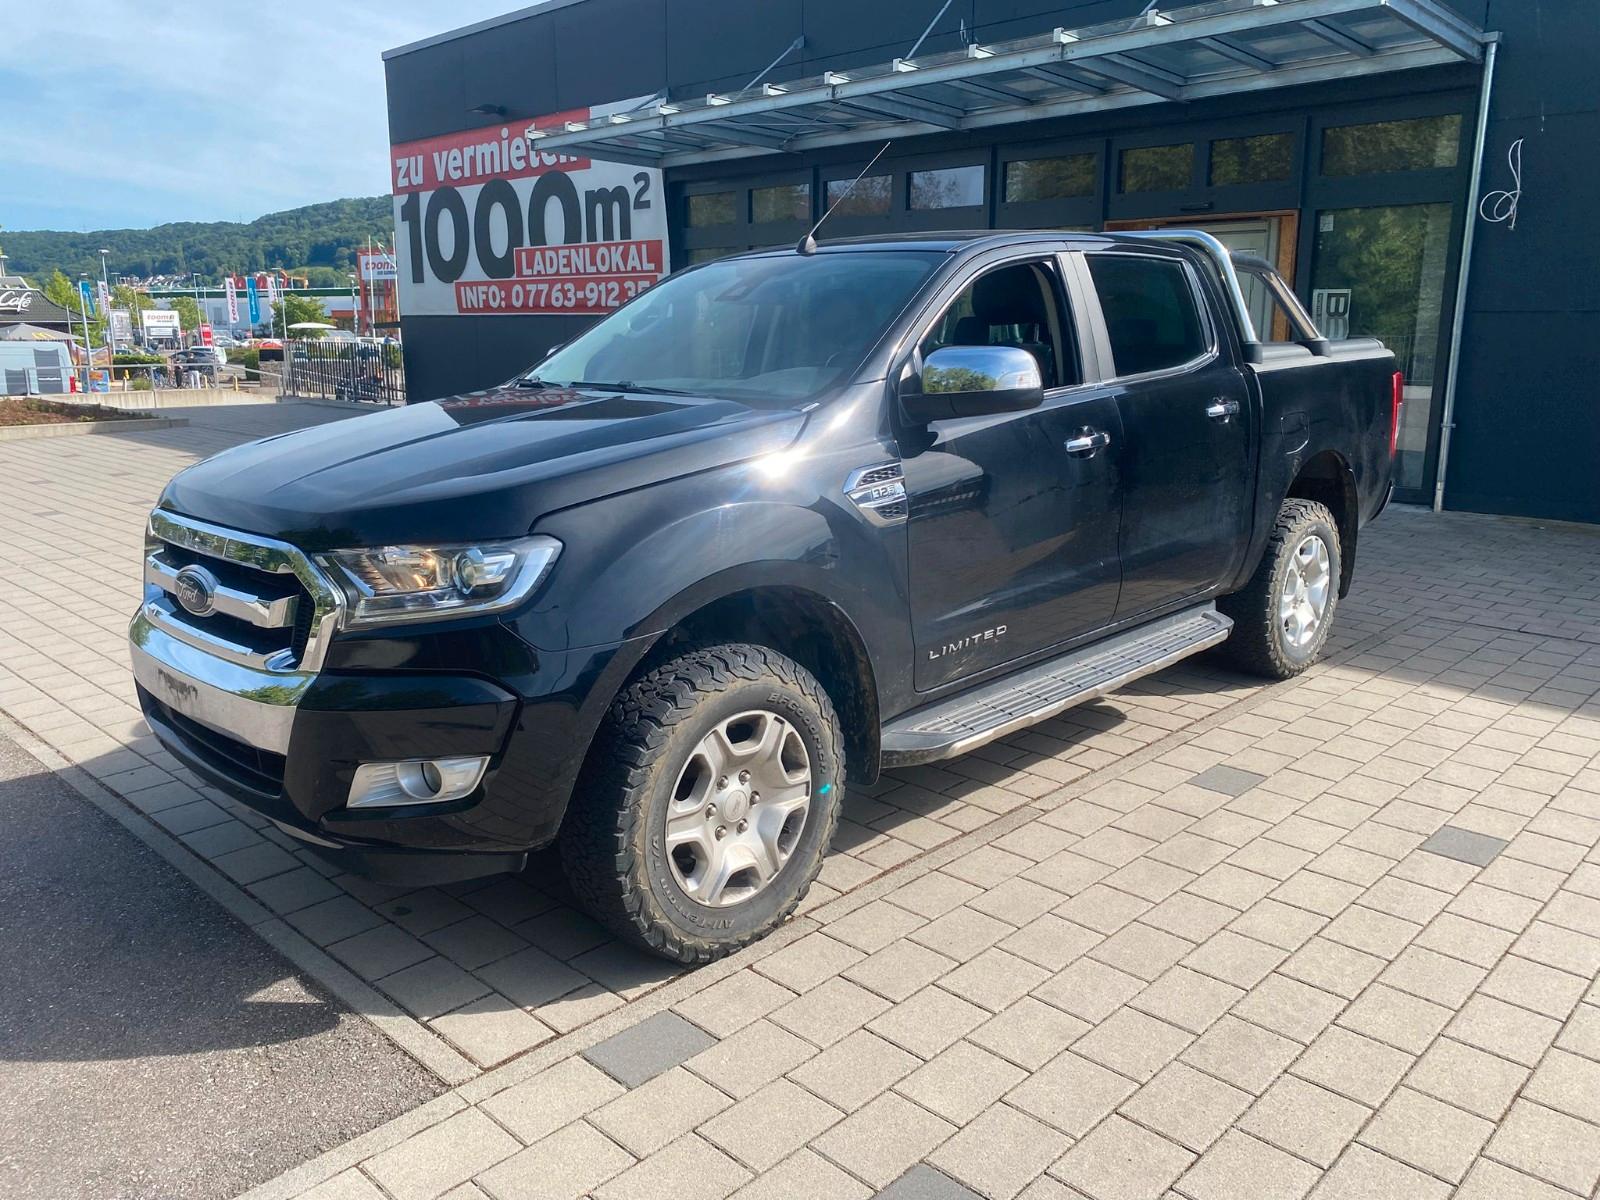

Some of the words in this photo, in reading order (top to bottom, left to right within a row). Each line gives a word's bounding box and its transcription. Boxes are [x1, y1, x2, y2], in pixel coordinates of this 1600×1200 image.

[395, 154, 424, 188] zu
[521, 246, 656, 277] LADENLOKAL
[460, 286, 506, 310] INFO:
[176, 577, 198, 603] Ford
[928, 624, 1008, 660] LIMITED
